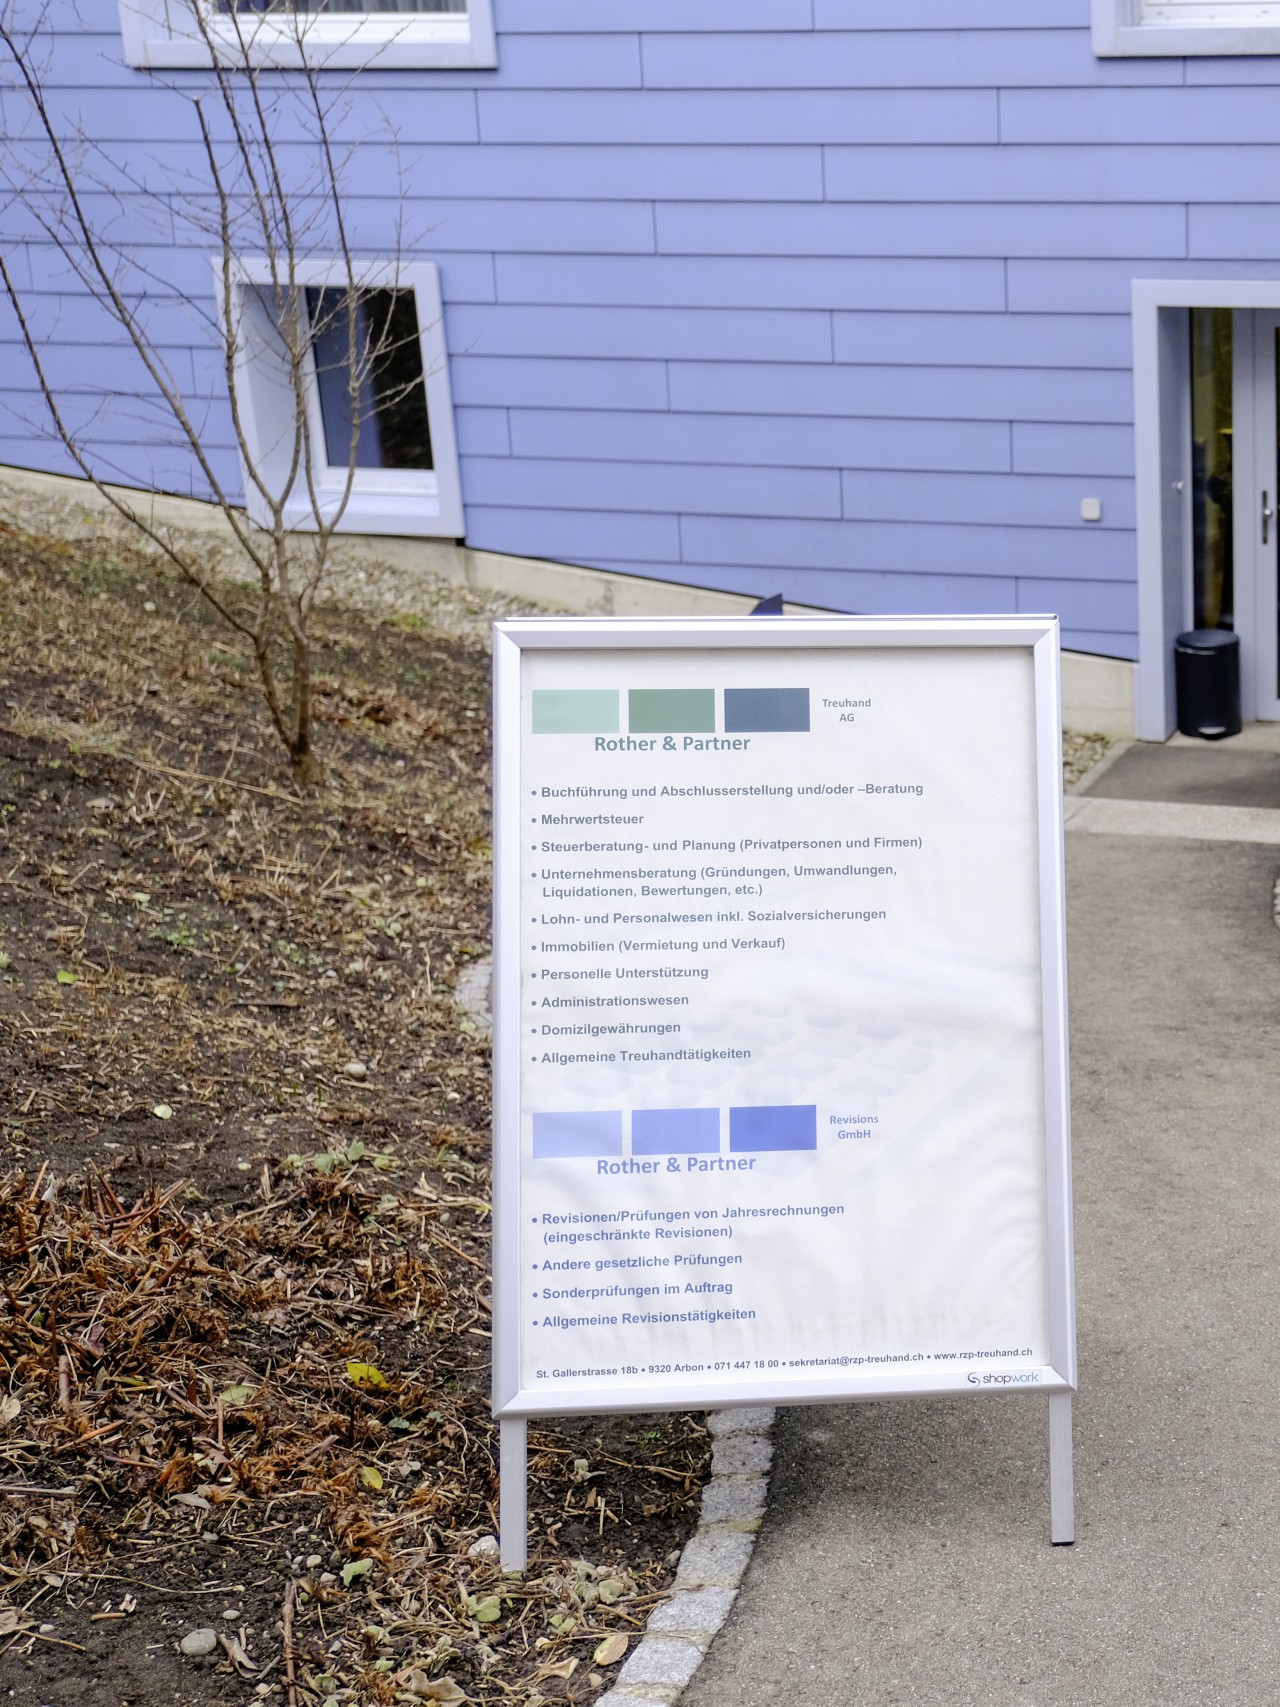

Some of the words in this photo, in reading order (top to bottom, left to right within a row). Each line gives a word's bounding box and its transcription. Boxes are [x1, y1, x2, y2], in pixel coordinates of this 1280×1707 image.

[821, 697, 872, 708] Treuhand
[839, 712, 855, 723] AG
[594, 735, 658, 752] Rother
[662, 735, 678, 751] &
[683, 736, 751, 751] Partner
[541, 786, 628, 800] Buchführung
[631, 785, 657, 797] und
[660, 784, 793, 798] Abschlusserstellung
[797, 783, 855, 795] und/oder
[541, 813, 645, 825] Mehrwertsteuer
[541, 840, 649, 854] Steuerberatung-
[652, 840, 678, 852] und
[682, 839, 736, 853] Planung
[739, 838, 842, 853] (Privatpersonen
[845, 837, 870, 849] und
[873, 836, 923, 850] Firmen)
[541, 867, 697, 881] Unternehmensberatung
[700, 866, 790, 881] (Gründungen,
[793, 864, 897, 878] Umwandlungen,
[542, 885, 637, 900] Liquidationen,
[641, 885, 731, 898] Bewertungen,
[734, 883, 763, 897] etc.)
[541, 913, 581, 925] Lohn-
[583, 912, 609, 925] und
[613, 911, 713, 924] Personalwesen
[716, 910, 744, 922] inkl.
[747, 909, 887, 922] Sozialversicherungen
[541, 940, 615, 953] Immobilien
[618, 939, 699, 954] (Vermietung
[702, 938, 728, 950] und
[730, 937, 786, 951] Verkauf)
[541, 968, 612, 980] Personelle
[615, 966, 709, 980] Unterstützung
[540, 995, 689, 1008] Administrationswesen
[541, 1022, 681, 1038] Domizilgewährungen
[541, 1051, 617, 1066] Allgemeine
[619, 1047, 752, 1063] Treuhandtätigkeiten
[829, 1114, 879, 1125] Revisions
[837, 1129, 871, 1140] GmbH
[597, 1157, 661, 1175] Rother
[666, 1156, 682, 1173] &
[687, 1156, 757, 1173] Partner
[542, 1209, 690, 1223] Revisionen/Prüfungen
[693, 1210, 718, 1220] von
[721, 1204, 845, 1219] Jahresrechnungen
[543, 1228, 651, 1246] (eingeschränkte
[655, 1225, 733, 1240] Revisionen)
[541, 1258, 591, 1271] Andere
[594, 1255, 670, 1272] gesetzliche
[673, 1253, 743, 1268] Prüfungen
[542, 1284, 660, 1300] Sonderprüfungen
[664, 1283, 680, 1295] im
[683, 1281, 733, 1295] Auftrag
[542, 1313, 618, 1330] Allgemeine
[621, 1308, 756, 1325] Revisionstätigkeiten
[536, 1369, 550, 1379] St.
[552, 1368, 618, 1378] Gallerstrasse
[620, 1365, 639, 1375] 18b
[648, 1364, 672, 1374] 9320
[673, 1363, 704, 1373] Arbon
[714, 1361, 731, 1371] 071
[733, 1360, 751, 1370] 447
[753, 1359, 766, 1369] 18
[767, 1359, 779, 1368] 00
[788, 1352, 924, 1368] sekretariat@rzp-treuhand.ch
[933, 1347, 1033, 1361] www.rzp-treuhand.ch
[982, 1372, 1039, 1385] shopwork
